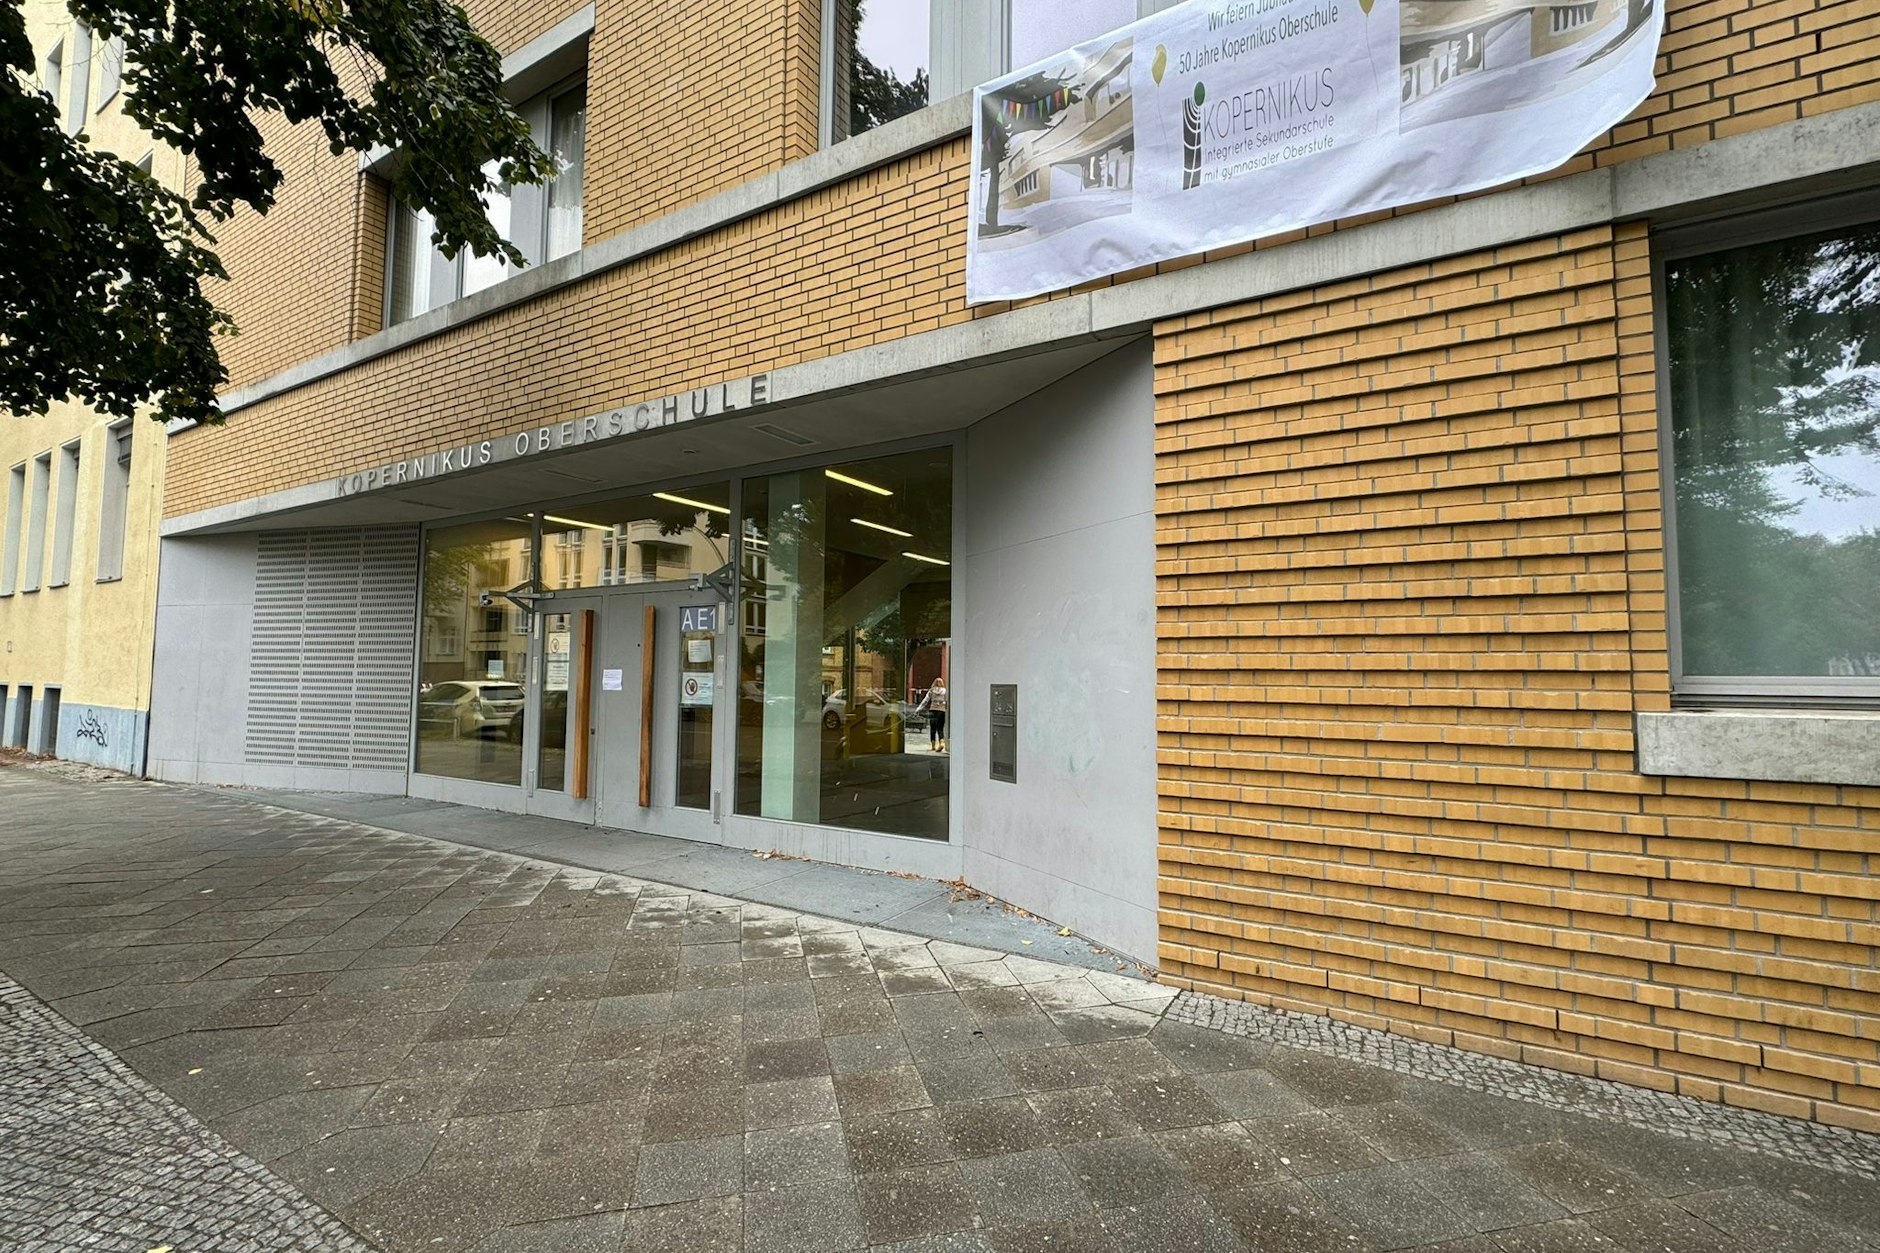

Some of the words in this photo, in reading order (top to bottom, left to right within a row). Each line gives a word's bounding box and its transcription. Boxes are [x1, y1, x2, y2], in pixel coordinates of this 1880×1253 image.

[1179, 51, 1192, 74] 50
[1193, 45, 1219, 70] Jahre
[1222, 24, 1277, 63] Kopernikus
[1279, 1, 1339, 40] Oberschule
[1208, 10, 1224, 32] Wir
[1226, 2, 1255, 25] feiern
[1203, 67, 1334, 143] KOPERNIKUS
[1204, 137, 1254, 164] Integrierte
[1256, 114, 1335, 148] Sekundarschule
[1204, 169, 1219, 183] mit
[1221, 146, 1280, 181] gymnasialer
[1282, 134, 1335, 160] Oberstufe
[336, 441, 493, 497] KOPERNIKUS
[515, 373, 768, 456] OBERSCHULE
